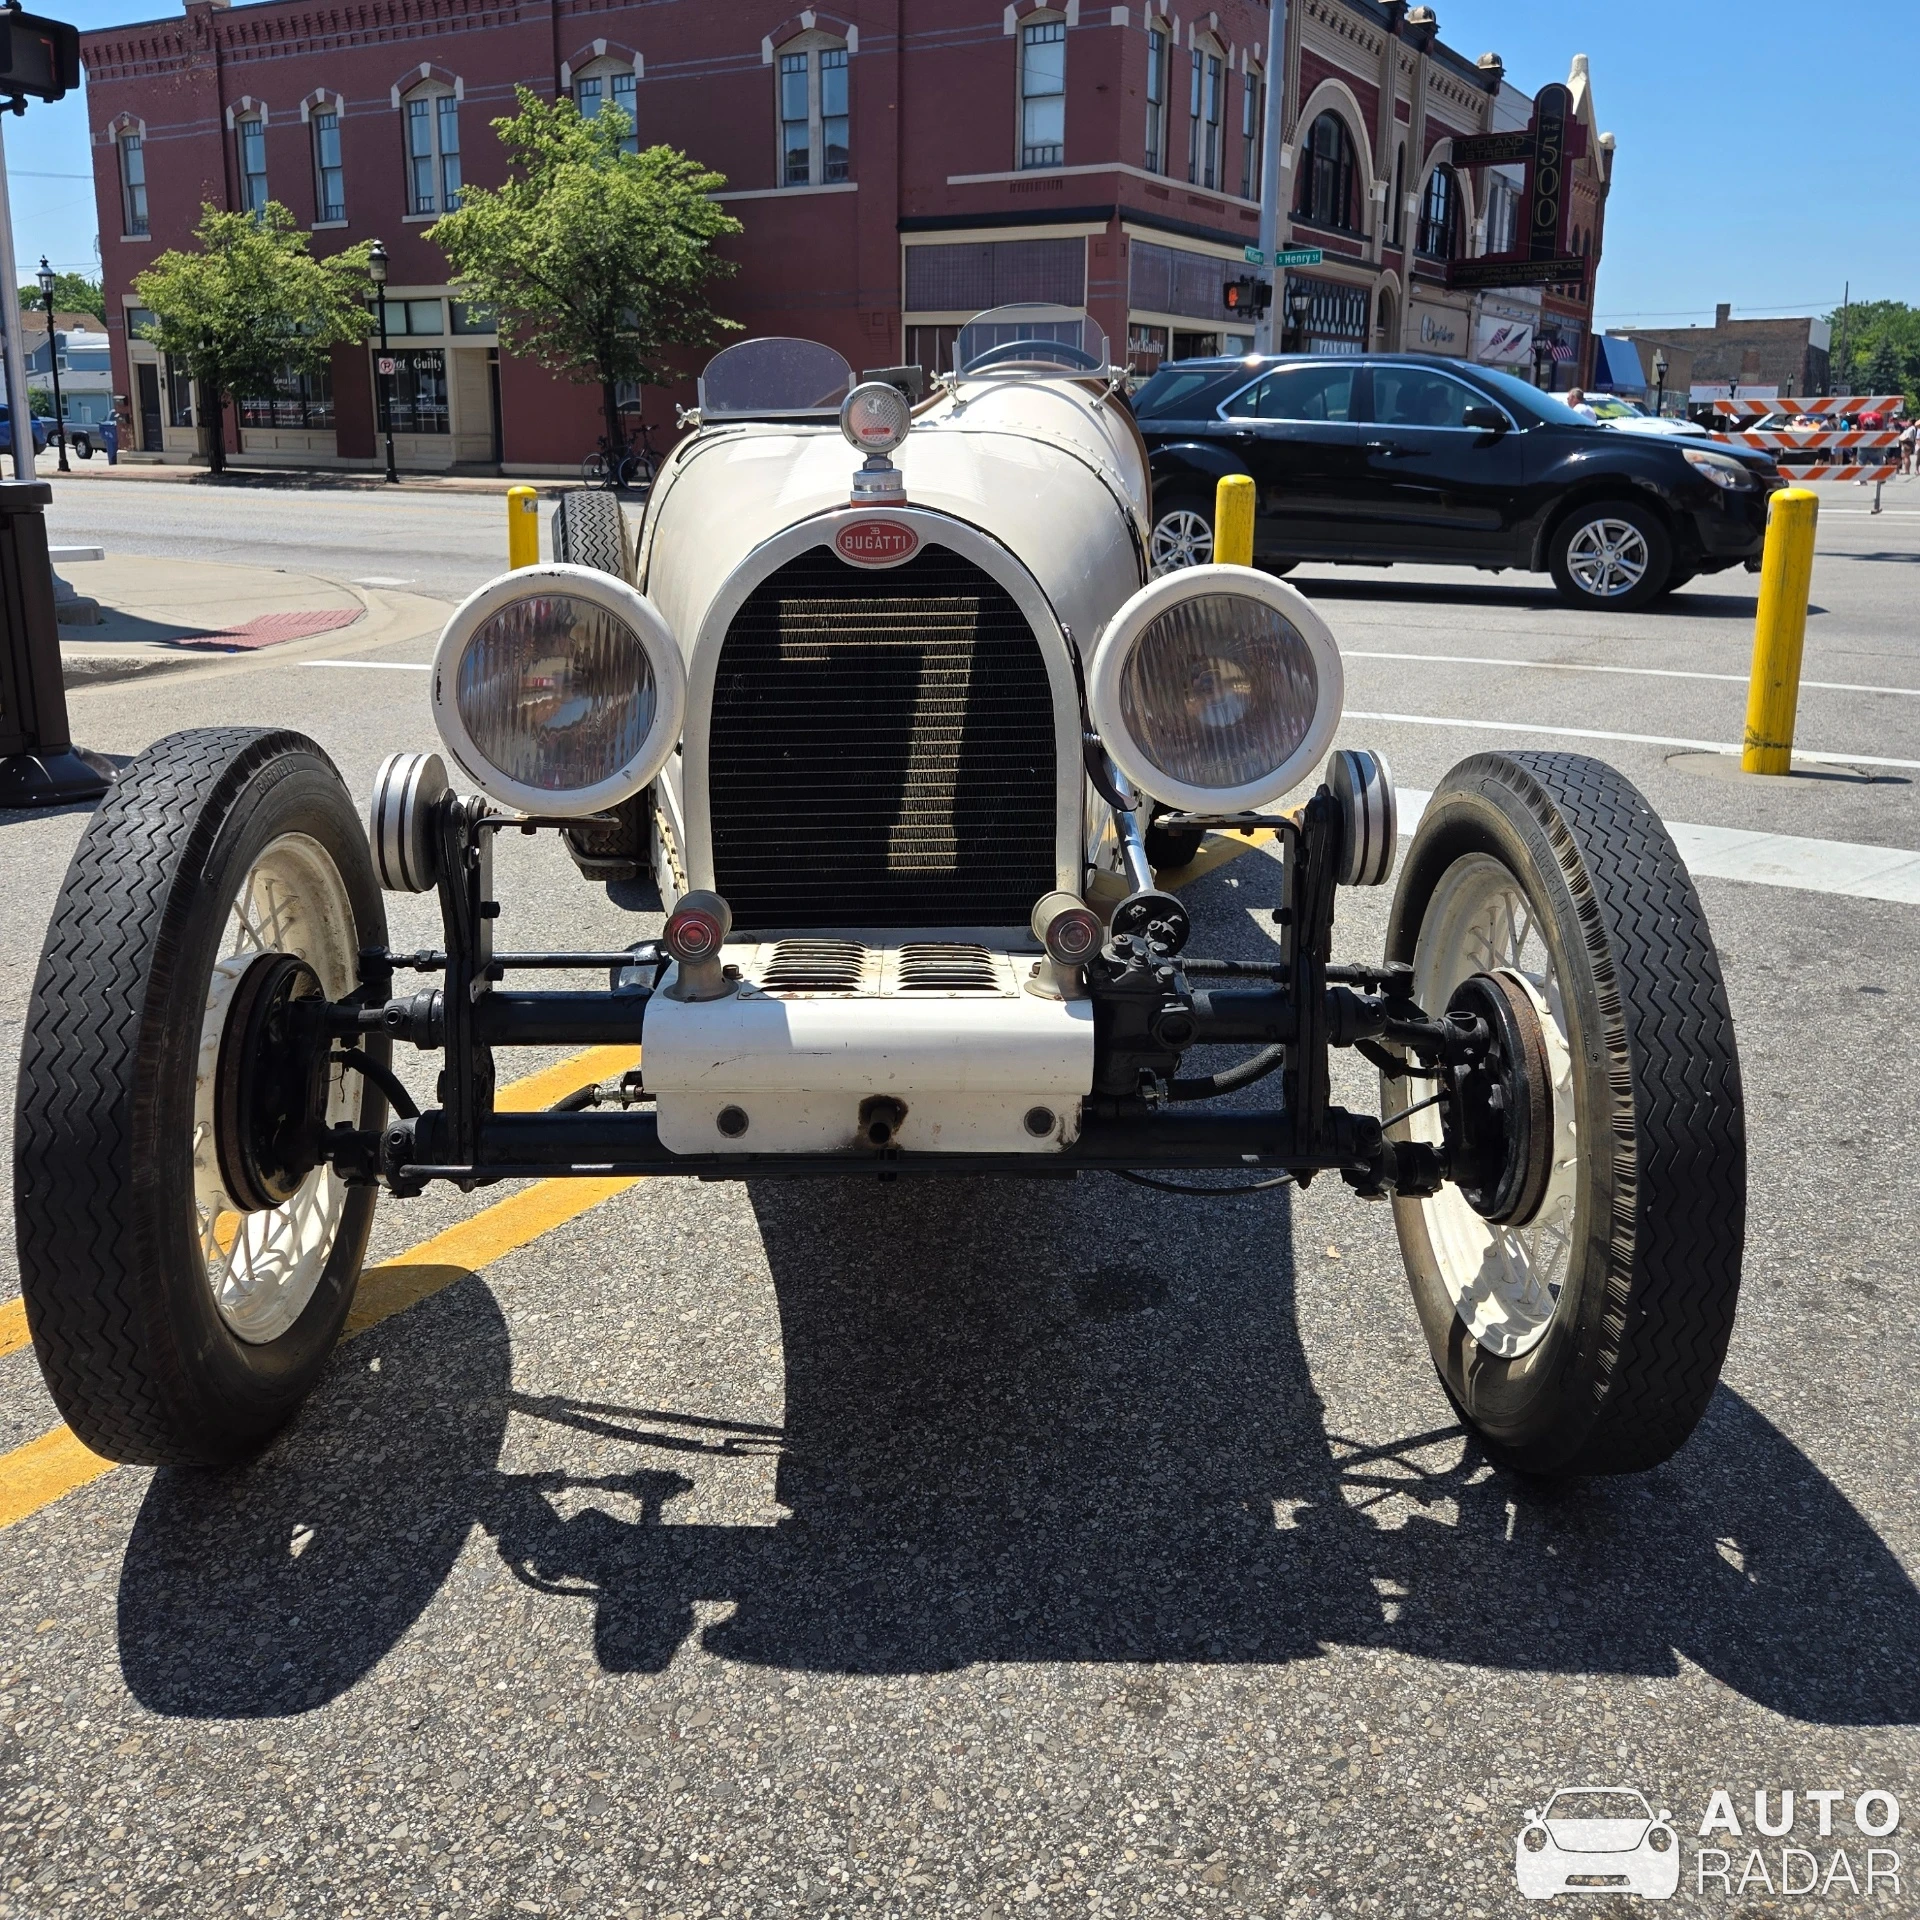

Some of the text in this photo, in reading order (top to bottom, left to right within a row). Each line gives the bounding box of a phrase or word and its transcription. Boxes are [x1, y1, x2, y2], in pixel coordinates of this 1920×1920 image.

[1541, 124, 1560, 132] THE
[1461, 137, 1525, 151] MIDLAND
[1465, 147, 1519, 160] STREET
[1534, 135, 1559, 227] 500
[1284, 253, 1310, 265] Henry
[1484, 266, 1511, 275] SPACE
[1518, 263, 1584, 273] MARKETPLACE
[1480, 271, 1557, 282] JAPANESE BISTRO
[1142, 340, 1164, 358] Guilty
[413, 357, 443, 371] Guilty
[845, 536, 906, 550] BUGATTI
[1527, 832, 1570, 914] GARFIELD
